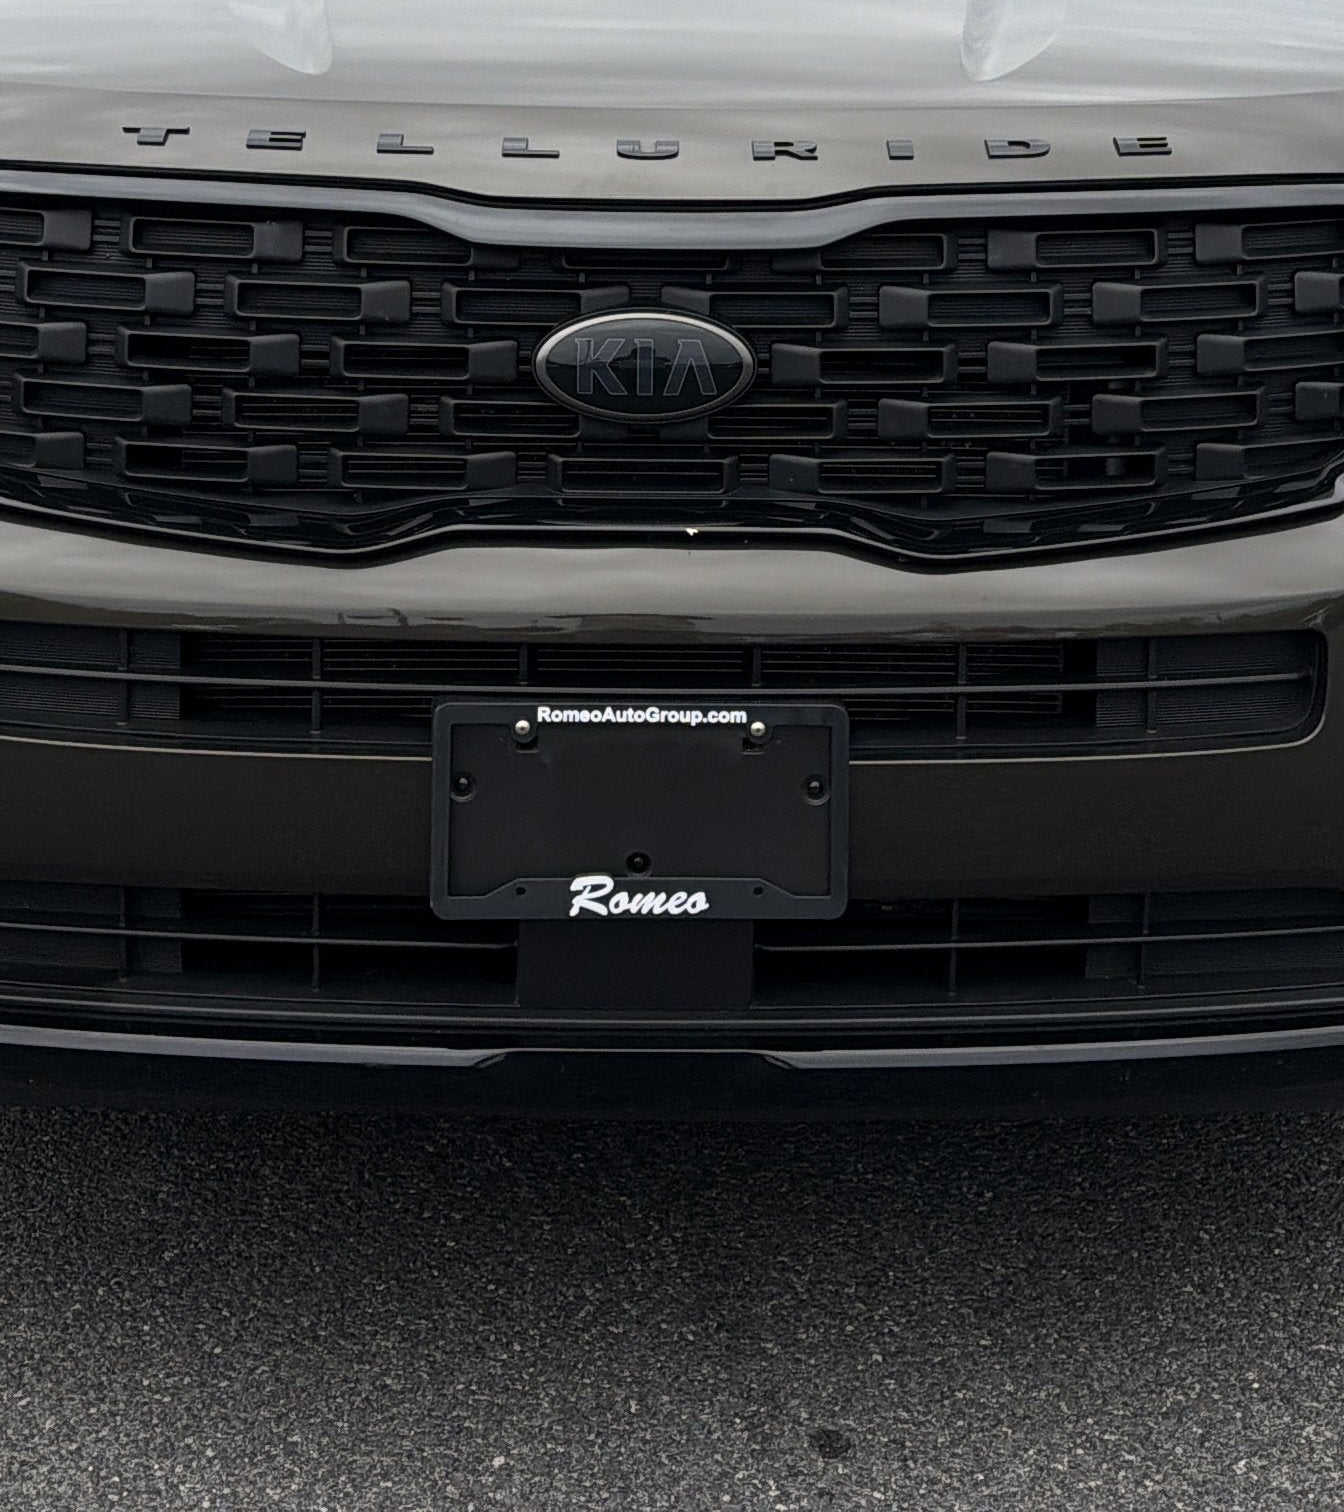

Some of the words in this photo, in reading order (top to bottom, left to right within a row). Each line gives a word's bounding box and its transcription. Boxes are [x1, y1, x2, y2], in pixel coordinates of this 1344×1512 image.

[122, 126, 1172, 161] TELLURIDE
[574, 338, 717, 397] KIA
[537, 706, 748, 726] RomeoAutoGroup.com
[569, 875, 710, 917] Romeo
